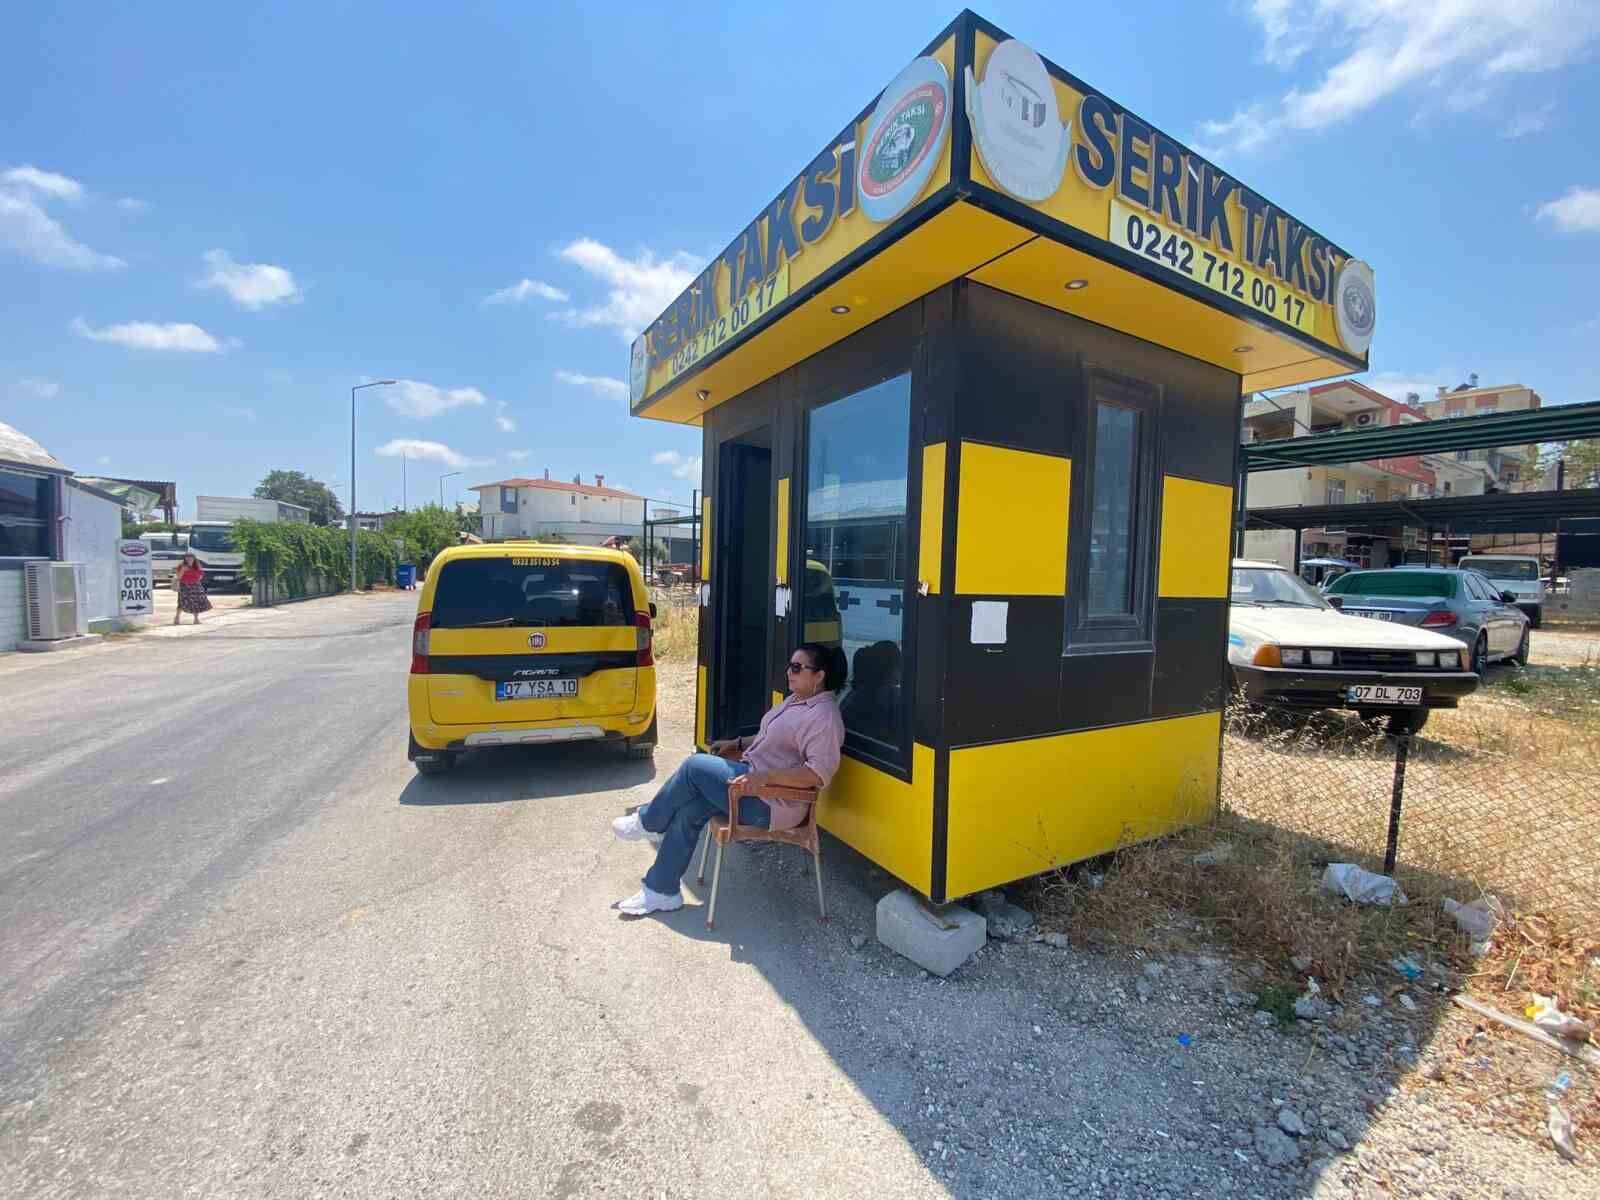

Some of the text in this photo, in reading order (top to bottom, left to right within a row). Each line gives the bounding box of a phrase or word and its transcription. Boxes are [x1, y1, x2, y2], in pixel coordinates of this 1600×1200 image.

[1127, 214, 1193, 276] 0242
[1202, 252, 1245, 299] 712
[1252, 278, 1276, 313] 00
[1283, 294, 1305, 326] 17
[672, 337, 698, 375] 0242
[703, 316, 727, 354] 712
[731, 296, 750, 333] 00
[756, 271, 777, 314] 17
[124, 577, 147, 589] OTO
[121, 589, 151, 601] PARK
[506, 680, 576, 696] 07 YSA 10
[1355, 686, 1420, 700] 07 DL 703
